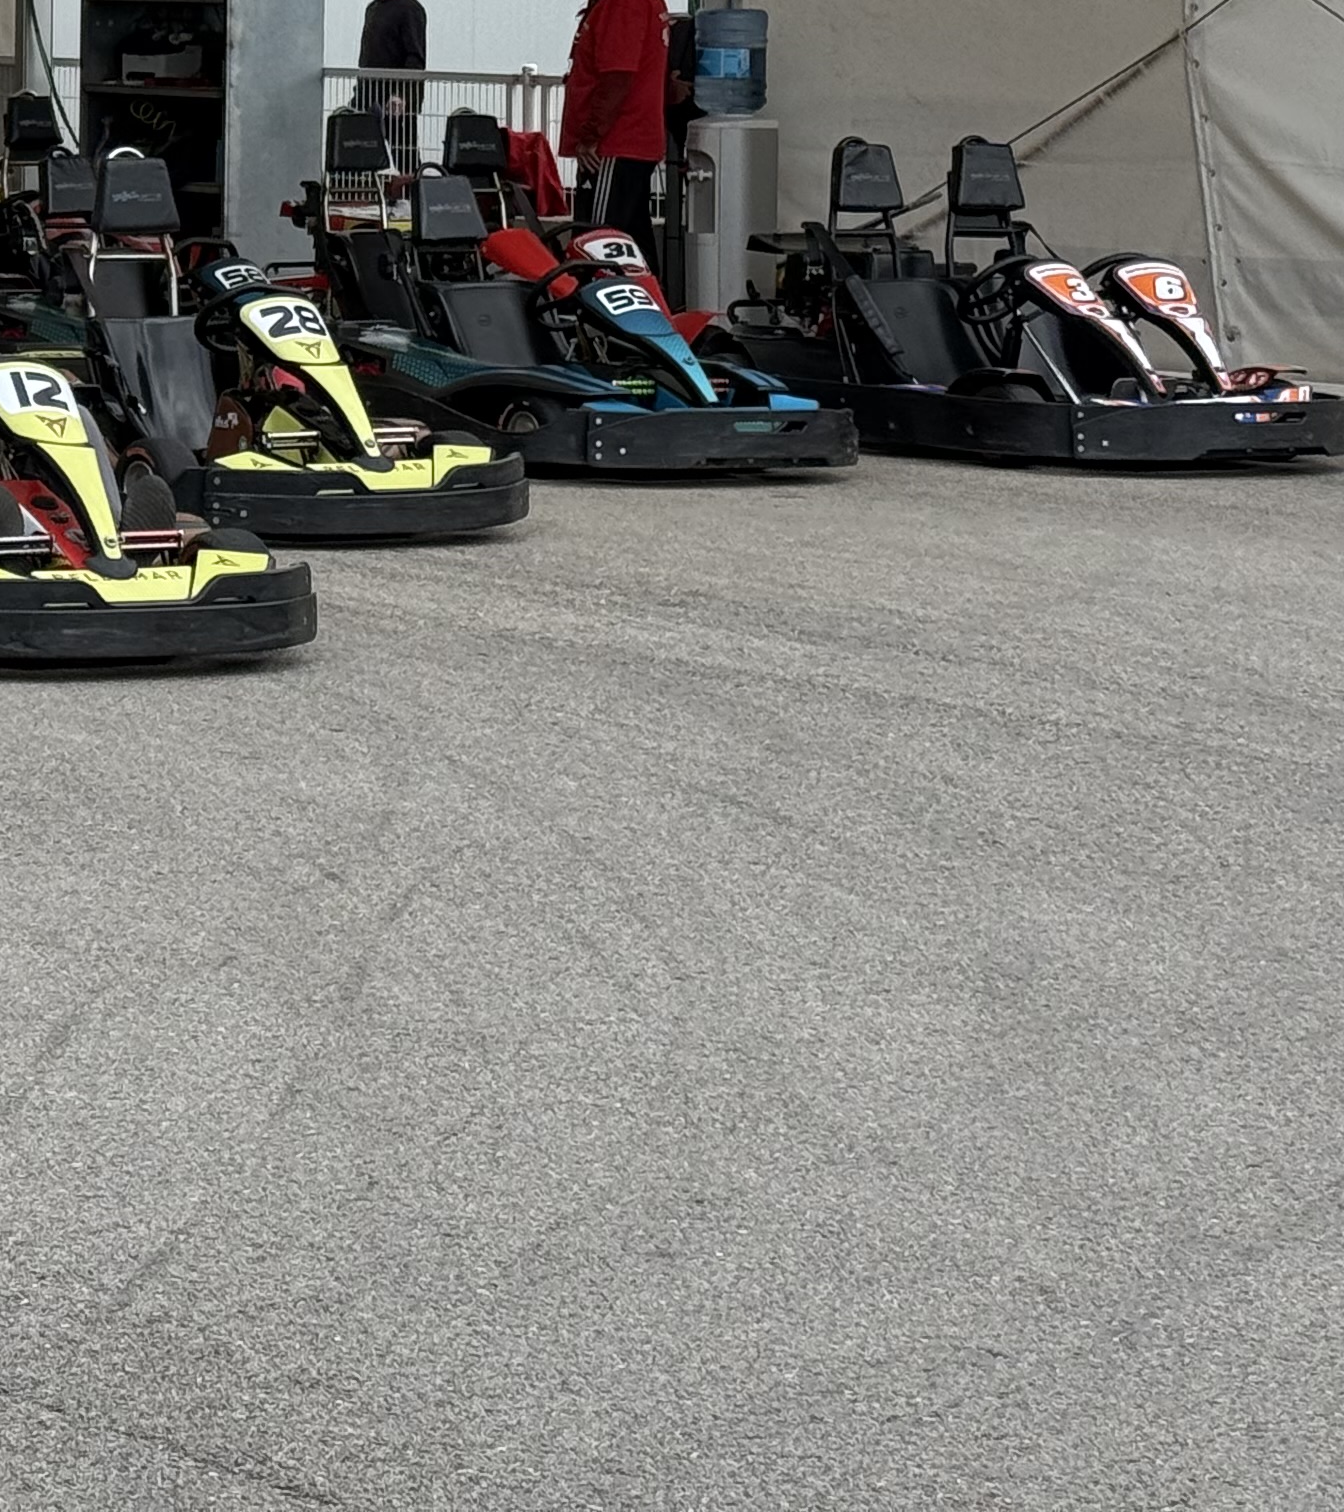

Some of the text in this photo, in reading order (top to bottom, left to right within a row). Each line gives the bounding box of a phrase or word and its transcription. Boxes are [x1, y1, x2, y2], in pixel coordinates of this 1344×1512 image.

[603, 242, 638, 259] 31
[604, 288, 654, 312] 59
[1065, 277, 1098, 303] 3
[1154, 276, 1186, 301] 6
[259, 305, 327, 339] 28
[10, 371, 70, 411] 12
